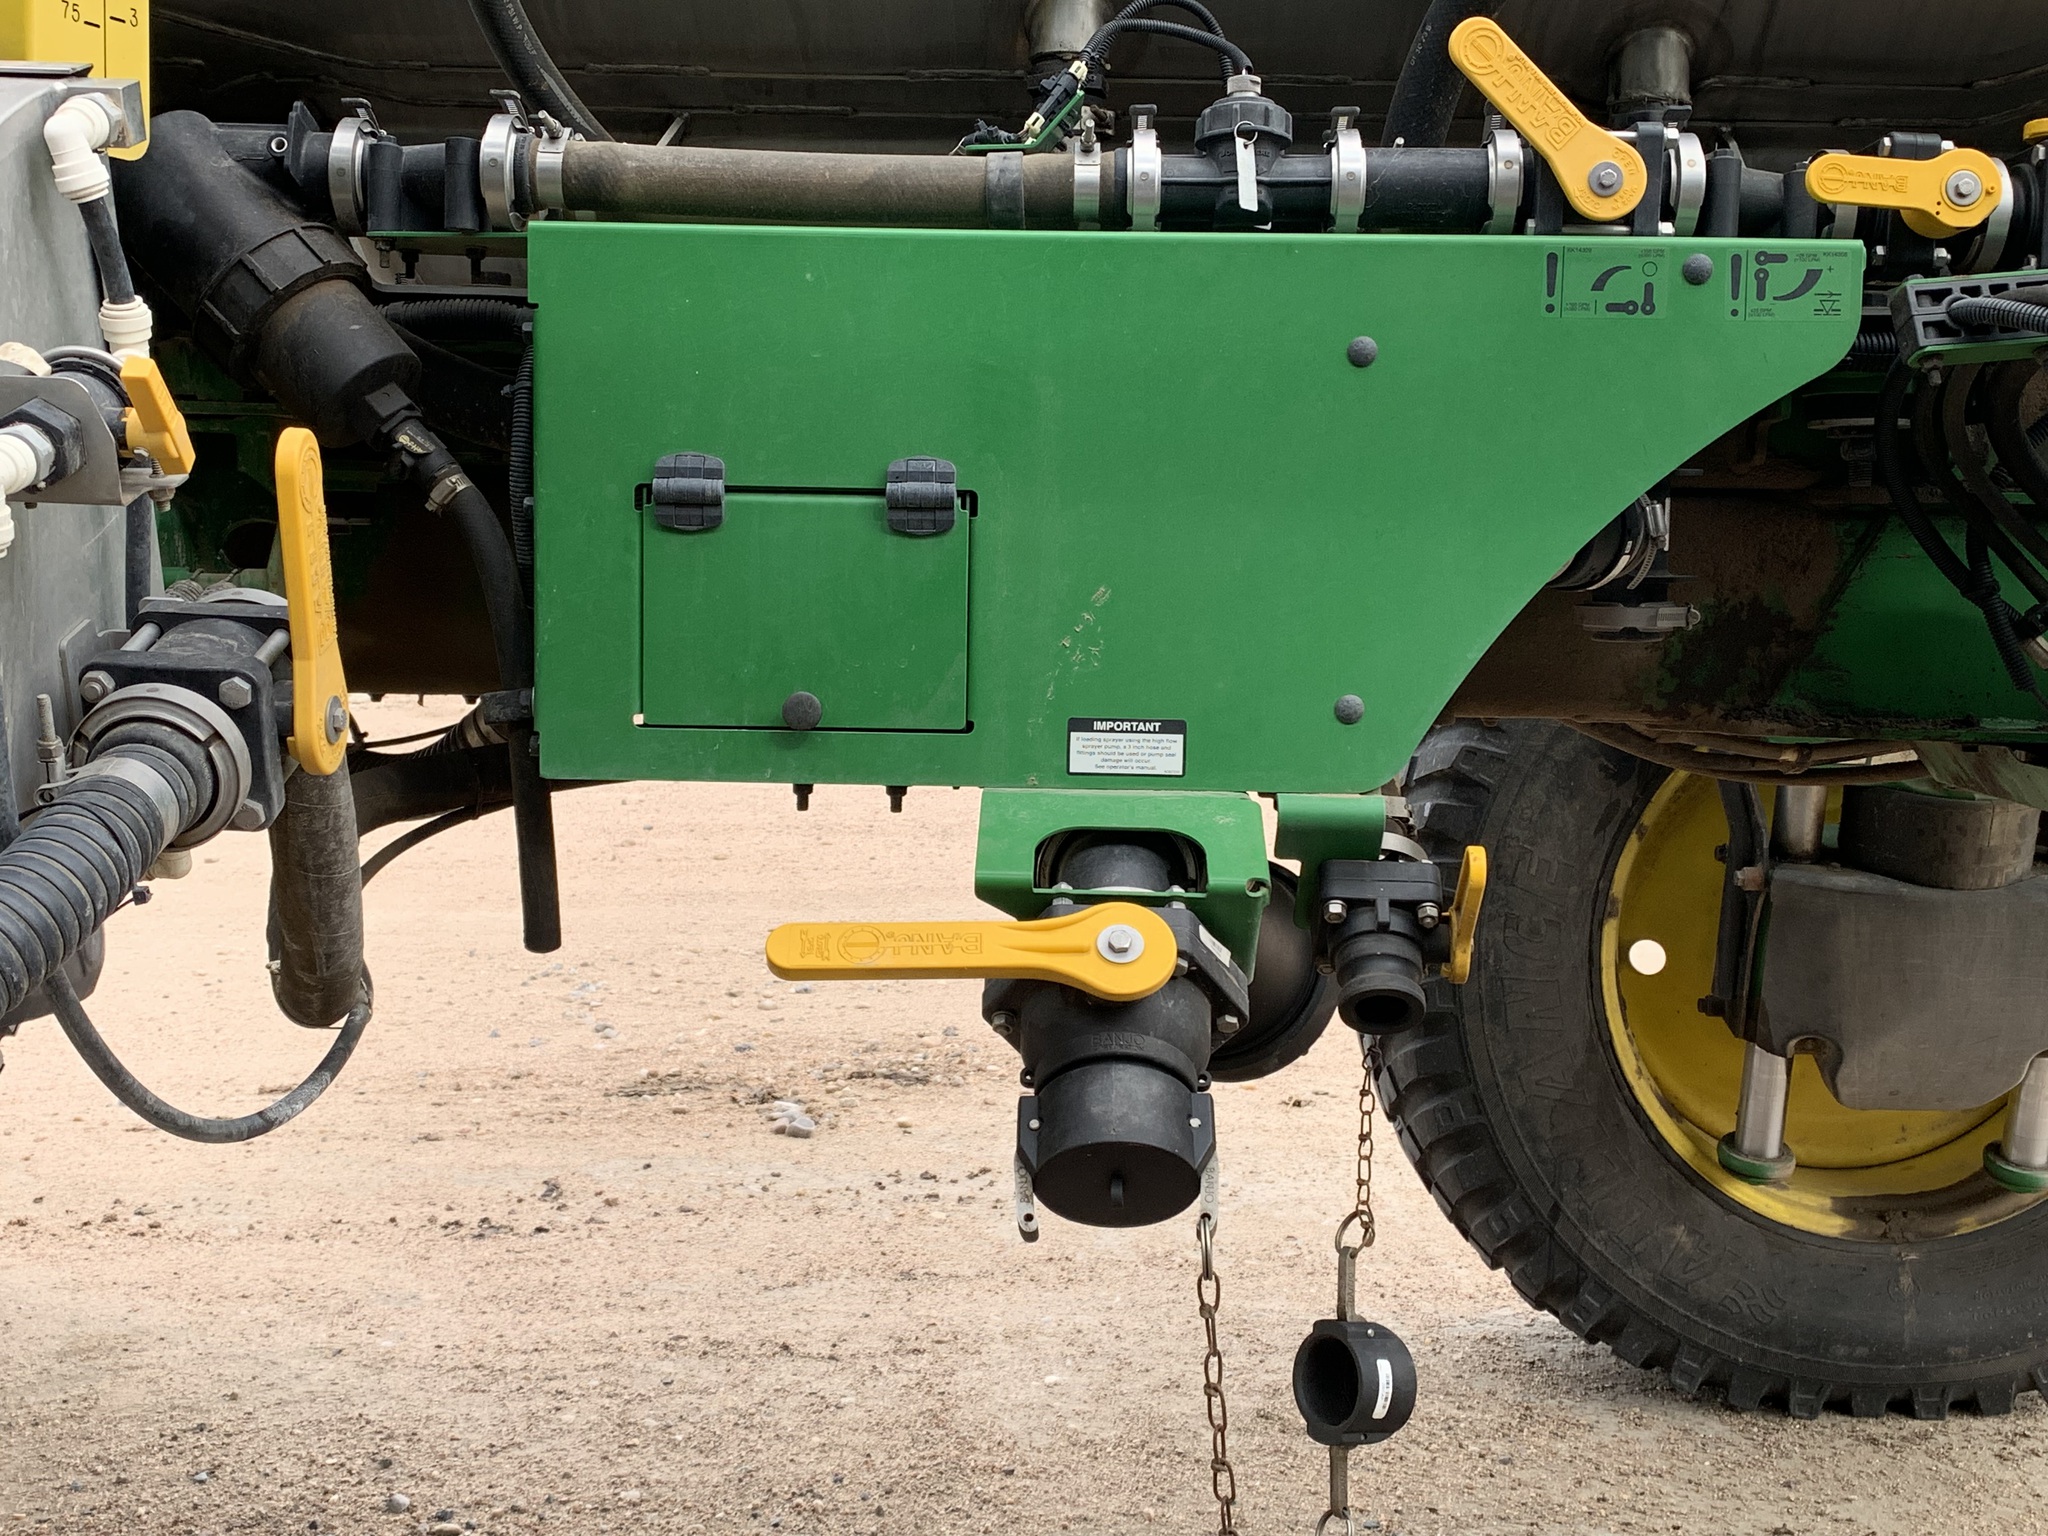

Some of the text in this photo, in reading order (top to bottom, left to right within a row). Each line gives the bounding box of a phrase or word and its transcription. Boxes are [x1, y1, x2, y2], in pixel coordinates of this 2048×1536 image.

[61, 0, 80, 22] 75
[129, 8, 138, 27] 3
[1460, 26, 1583, 152] BANJO
[1093, 720, 1162, 732] IMPORTANT
[1152, 737, 1165, 745] high
[836, 924, 983, 966] BANJO
[1091, 1032, 1146, 1046] BANJO
[1017, 1166, 1031, 1204] BANJO
[1204, 1167, 1215, 1204] BANJO
